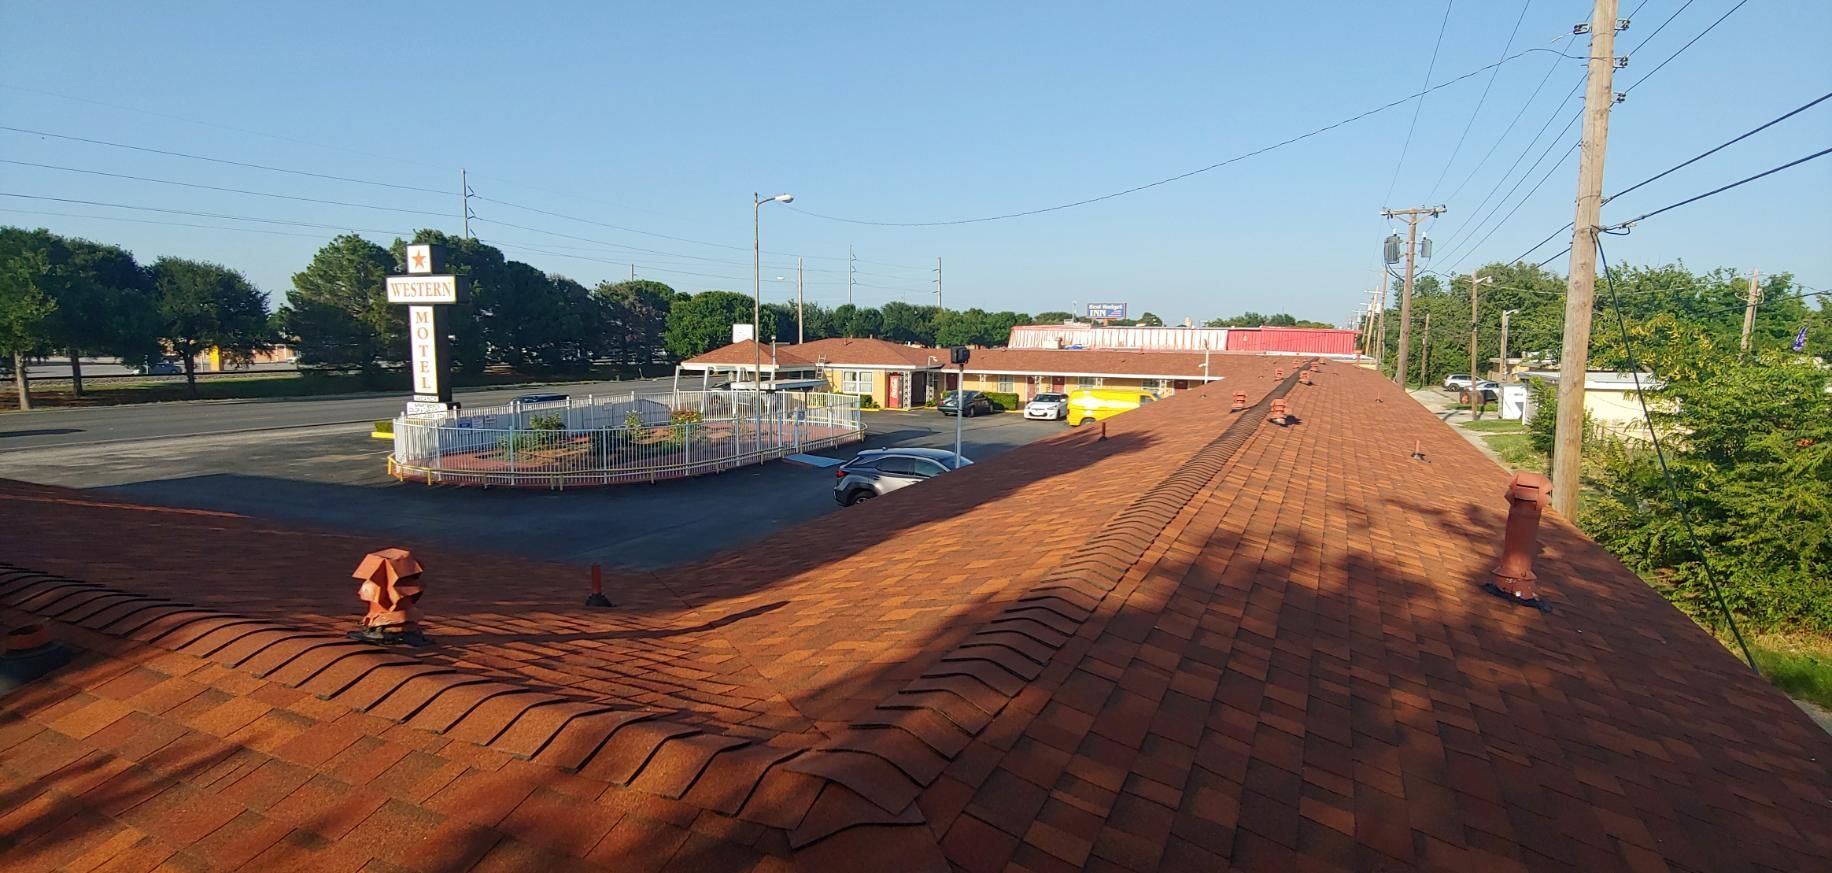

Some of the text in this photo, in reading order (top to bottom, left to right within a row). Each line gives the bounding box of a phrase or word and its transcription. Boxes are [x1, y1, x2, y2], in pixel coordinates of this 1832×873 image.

[391, 282, 452, 298] WESTERN
[1089, 309, 1106, 317] INN
[415, 311, 431, 389] MOTEL
